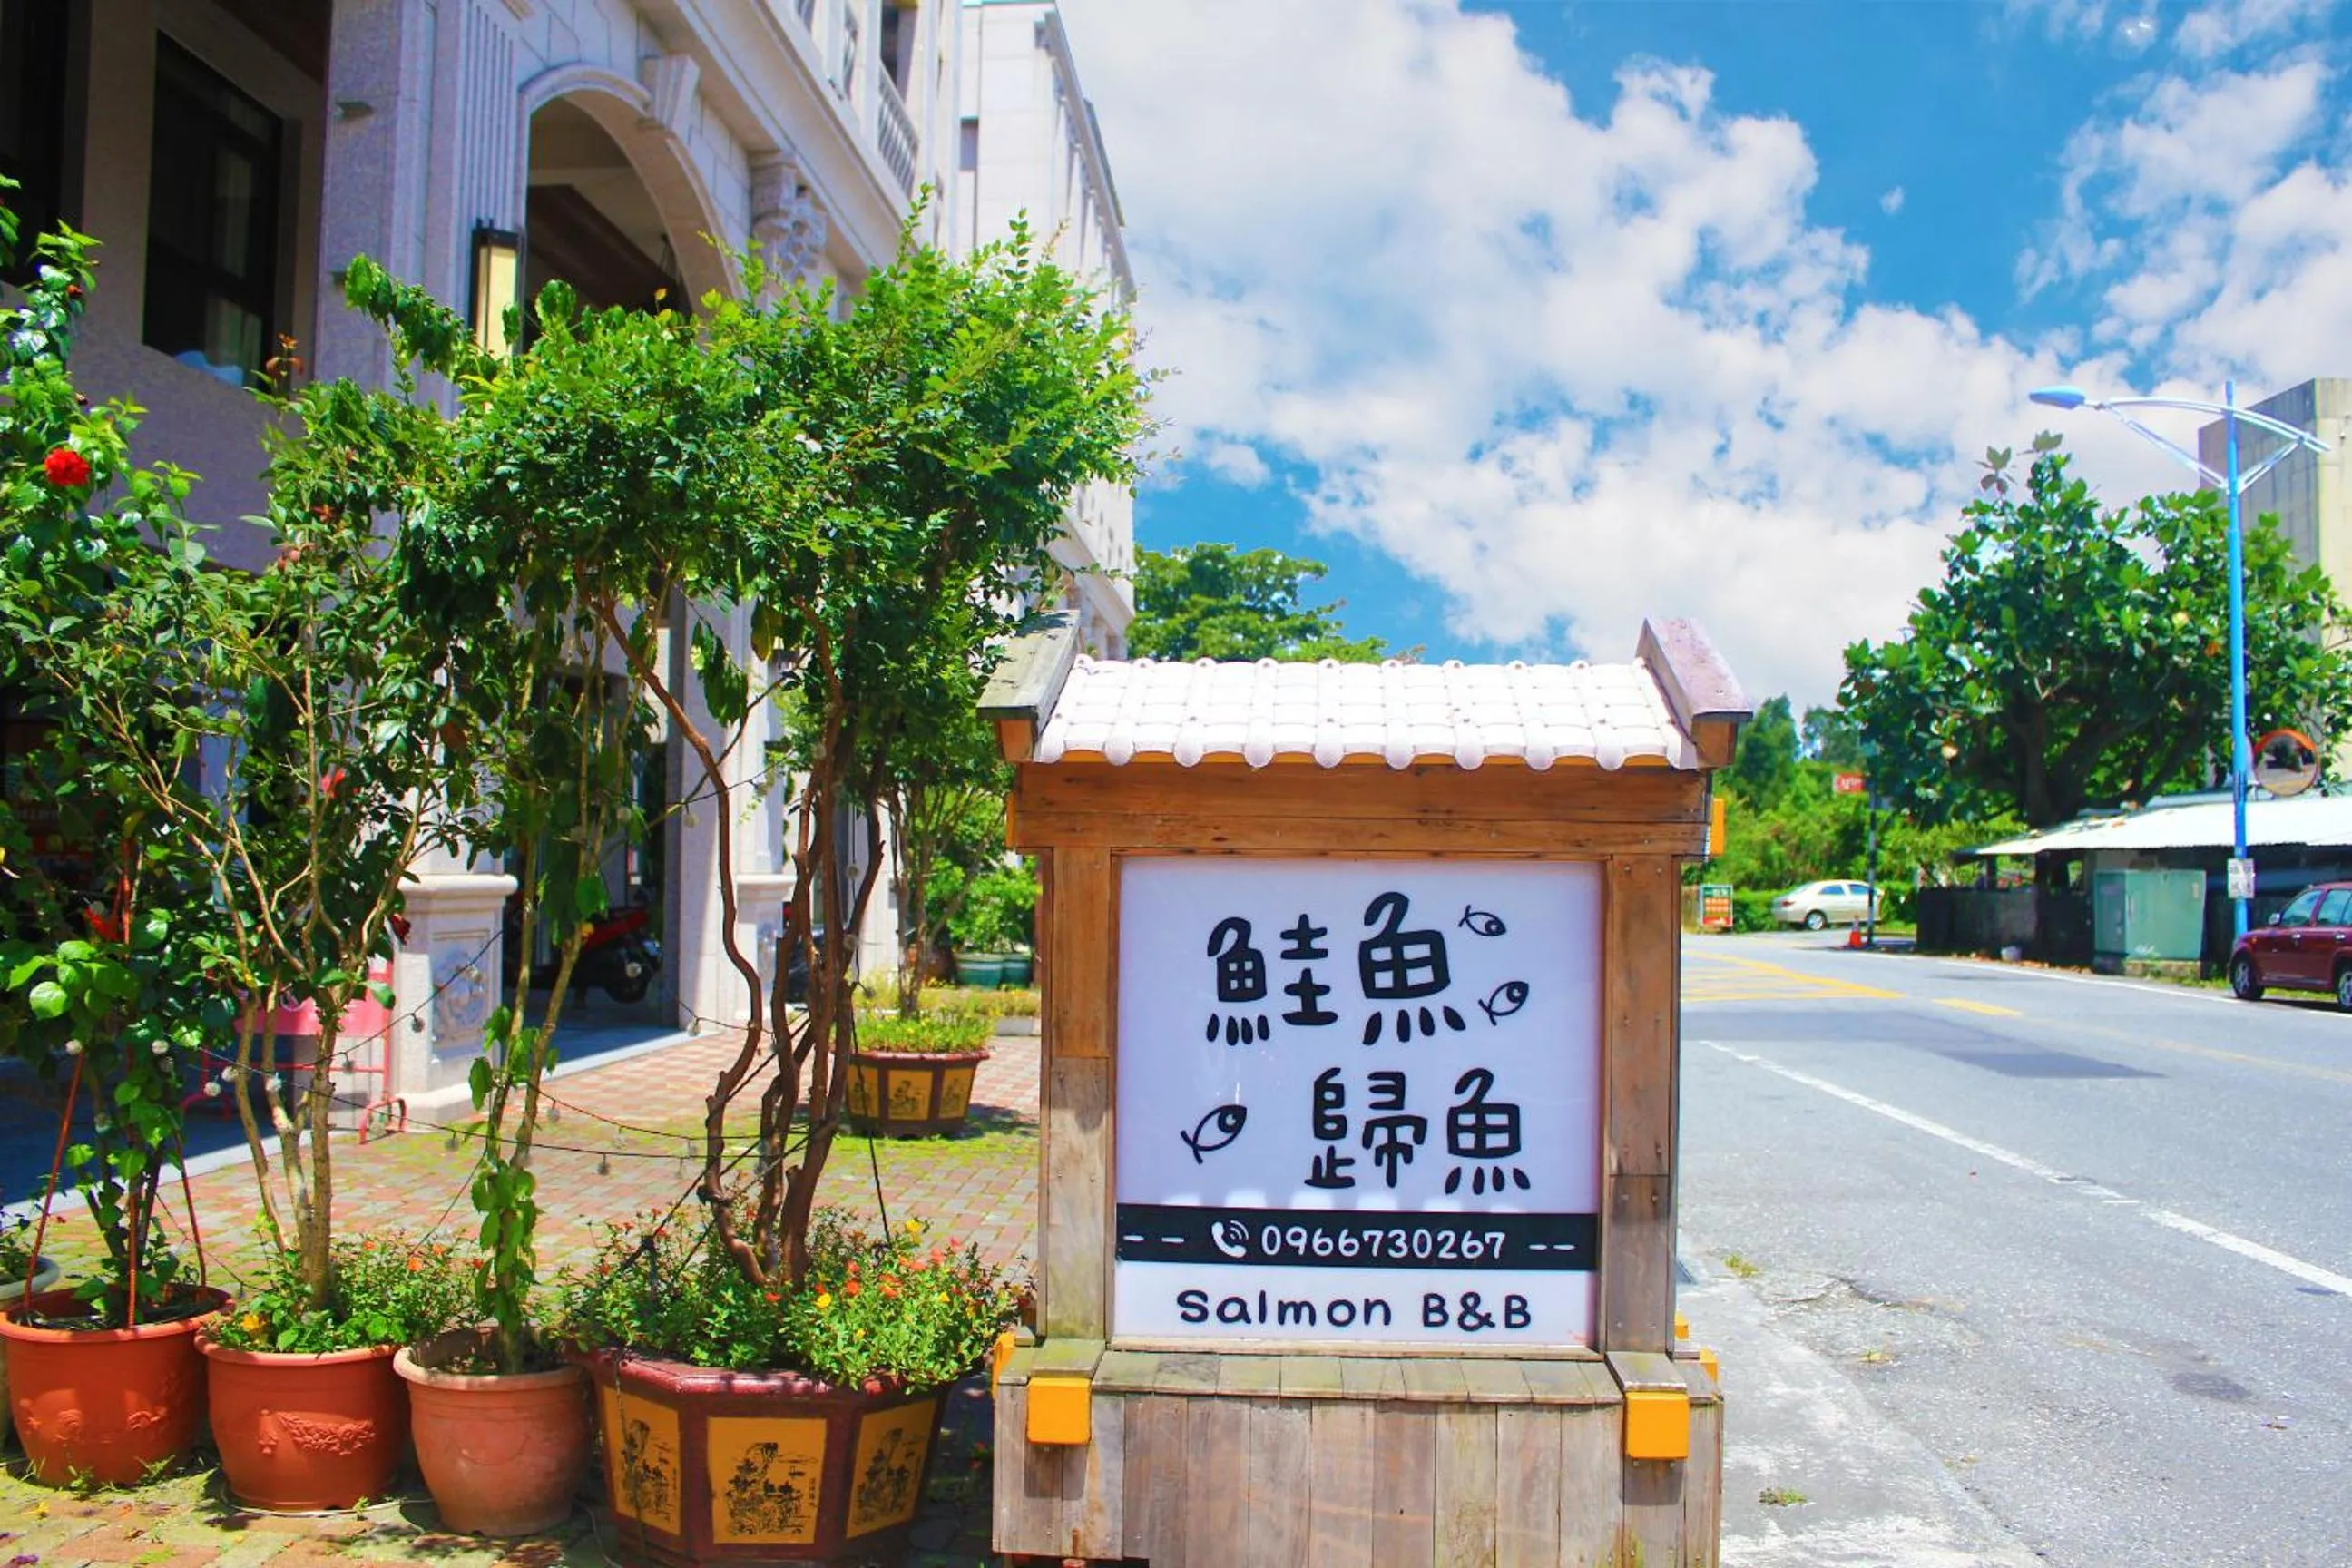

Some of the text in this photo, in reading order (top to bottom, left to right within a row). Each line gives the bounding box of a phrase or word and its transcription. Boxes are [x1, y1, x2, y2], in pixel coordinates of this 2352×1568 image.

[1206, 891, 1467, 1046] 鮭魚
[1304, 1067, 1531, 1195] 歸魚
[1261, 1225, 1506, 1259] 0966730267
[1176, 1289, 1532, 1332] Salmon B&B
